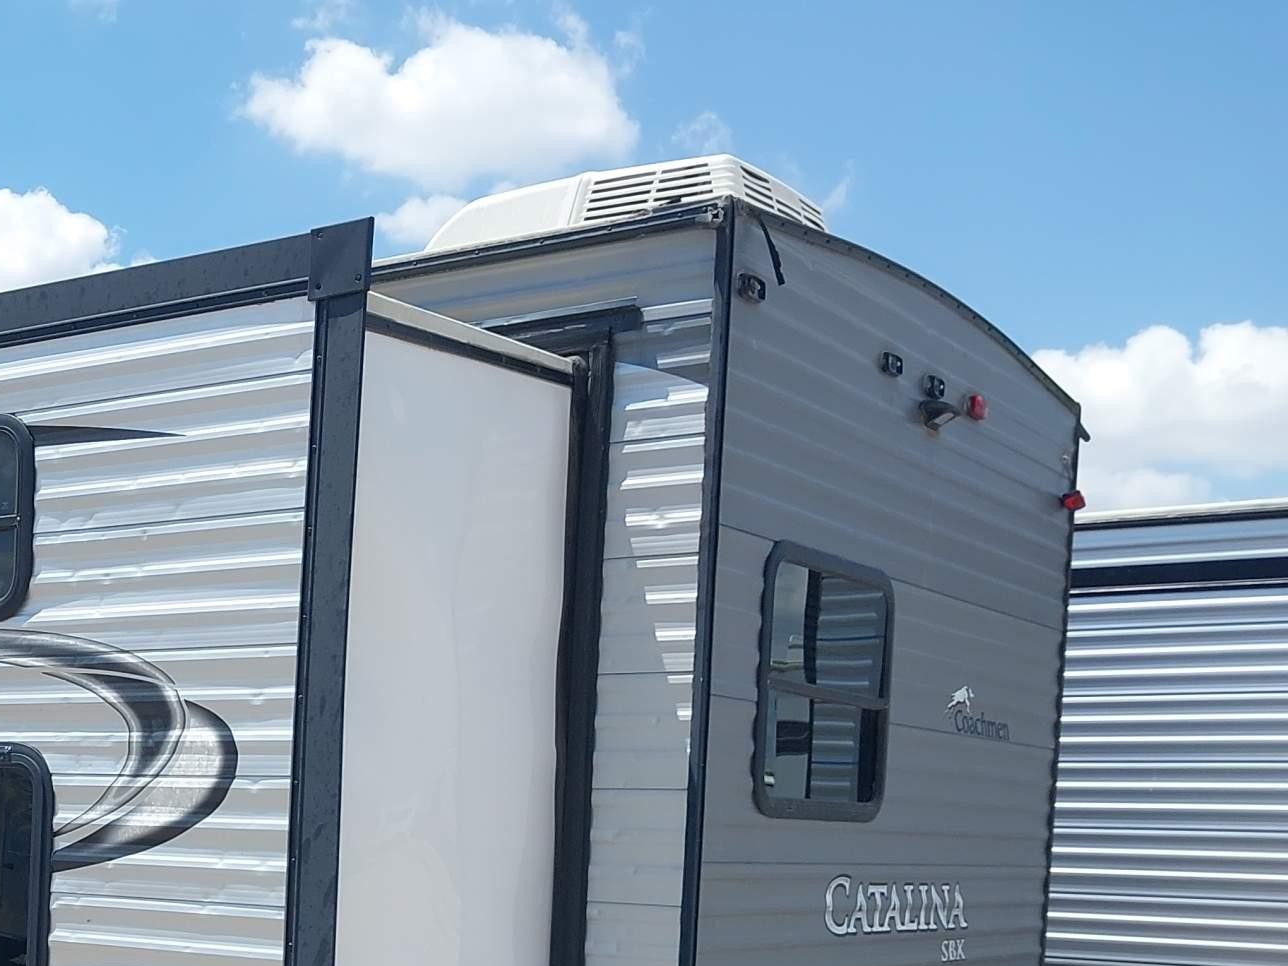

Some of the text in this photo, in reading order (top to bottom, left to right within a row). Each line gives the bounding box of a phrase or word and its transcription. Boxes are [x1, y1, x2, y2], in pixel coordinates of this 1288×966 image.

[954, 709, 1010, 742] Coachmen
[824, 874, 969, 937] CATALINA
[940, 938, 966, 963] SBX
